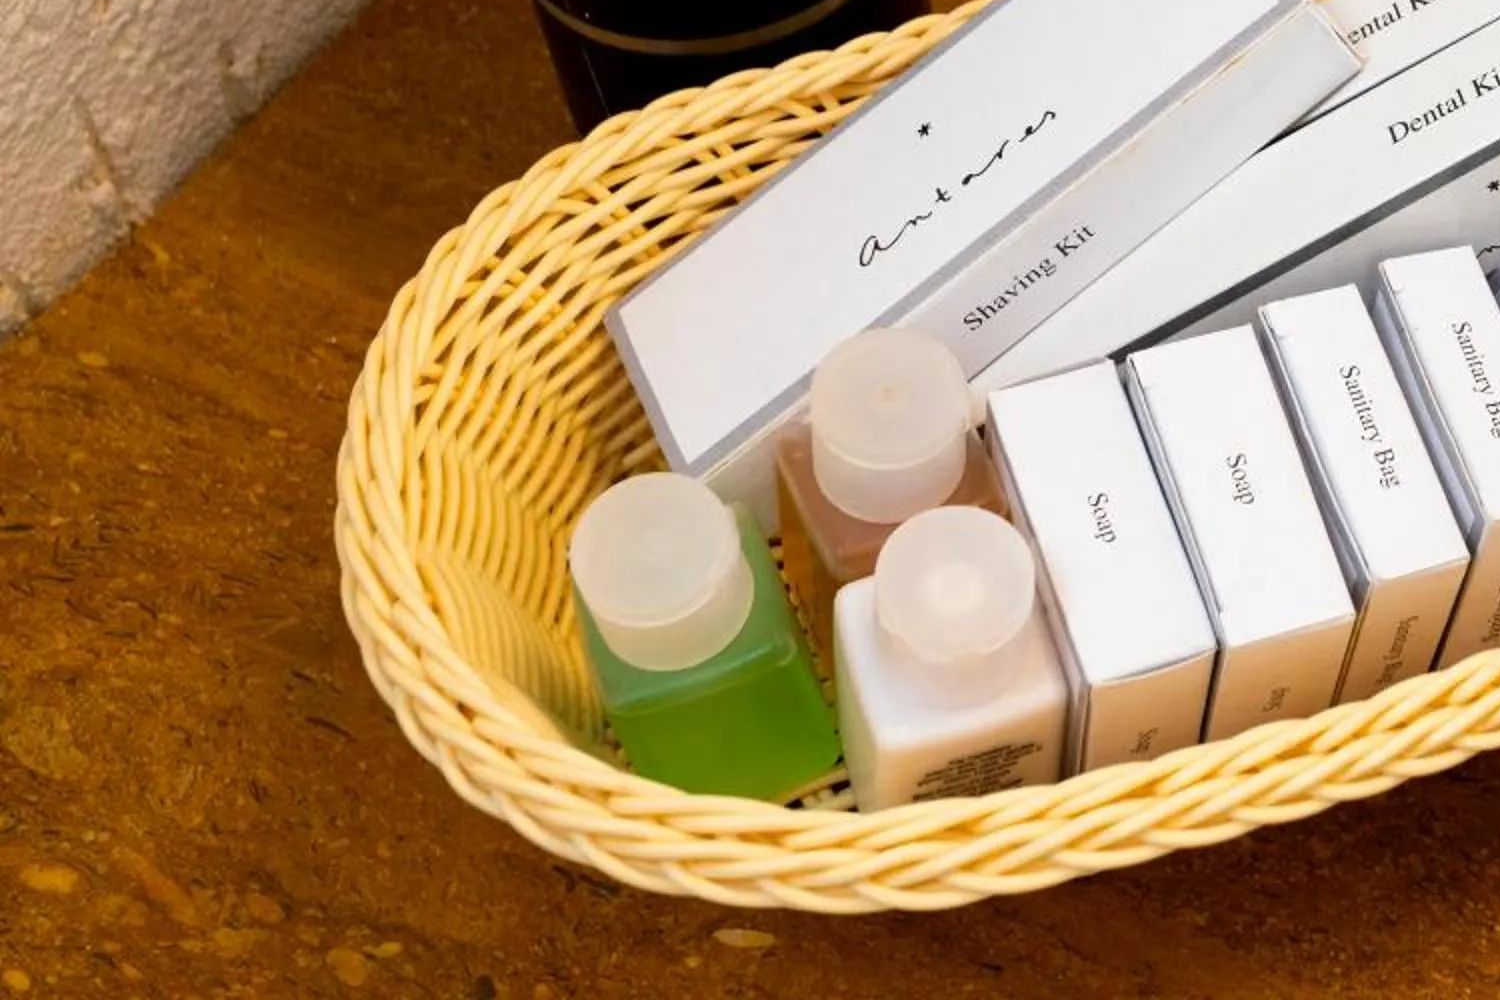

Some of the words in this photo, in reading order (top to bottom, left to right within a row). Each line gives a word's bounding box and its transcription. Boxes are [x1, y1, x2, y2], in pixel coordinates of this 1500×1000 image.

[1347, 2, 1404, 45] ental
[1387, 88, 1468, 145] Dental
[859, 110, 1056, 267] antares
[962, 257, 1056, 331] Shaving
[1055, 224, 1096, 258] Kit
[1452, 321, 1495, 397] Sanitary
[1339, 364, 1382, 445] Sanitary
[1374, 447, 1400, 489] Bag
[1226, 452, 1255, 506] Soap
[1087, 492, 1117, 544] Soap
